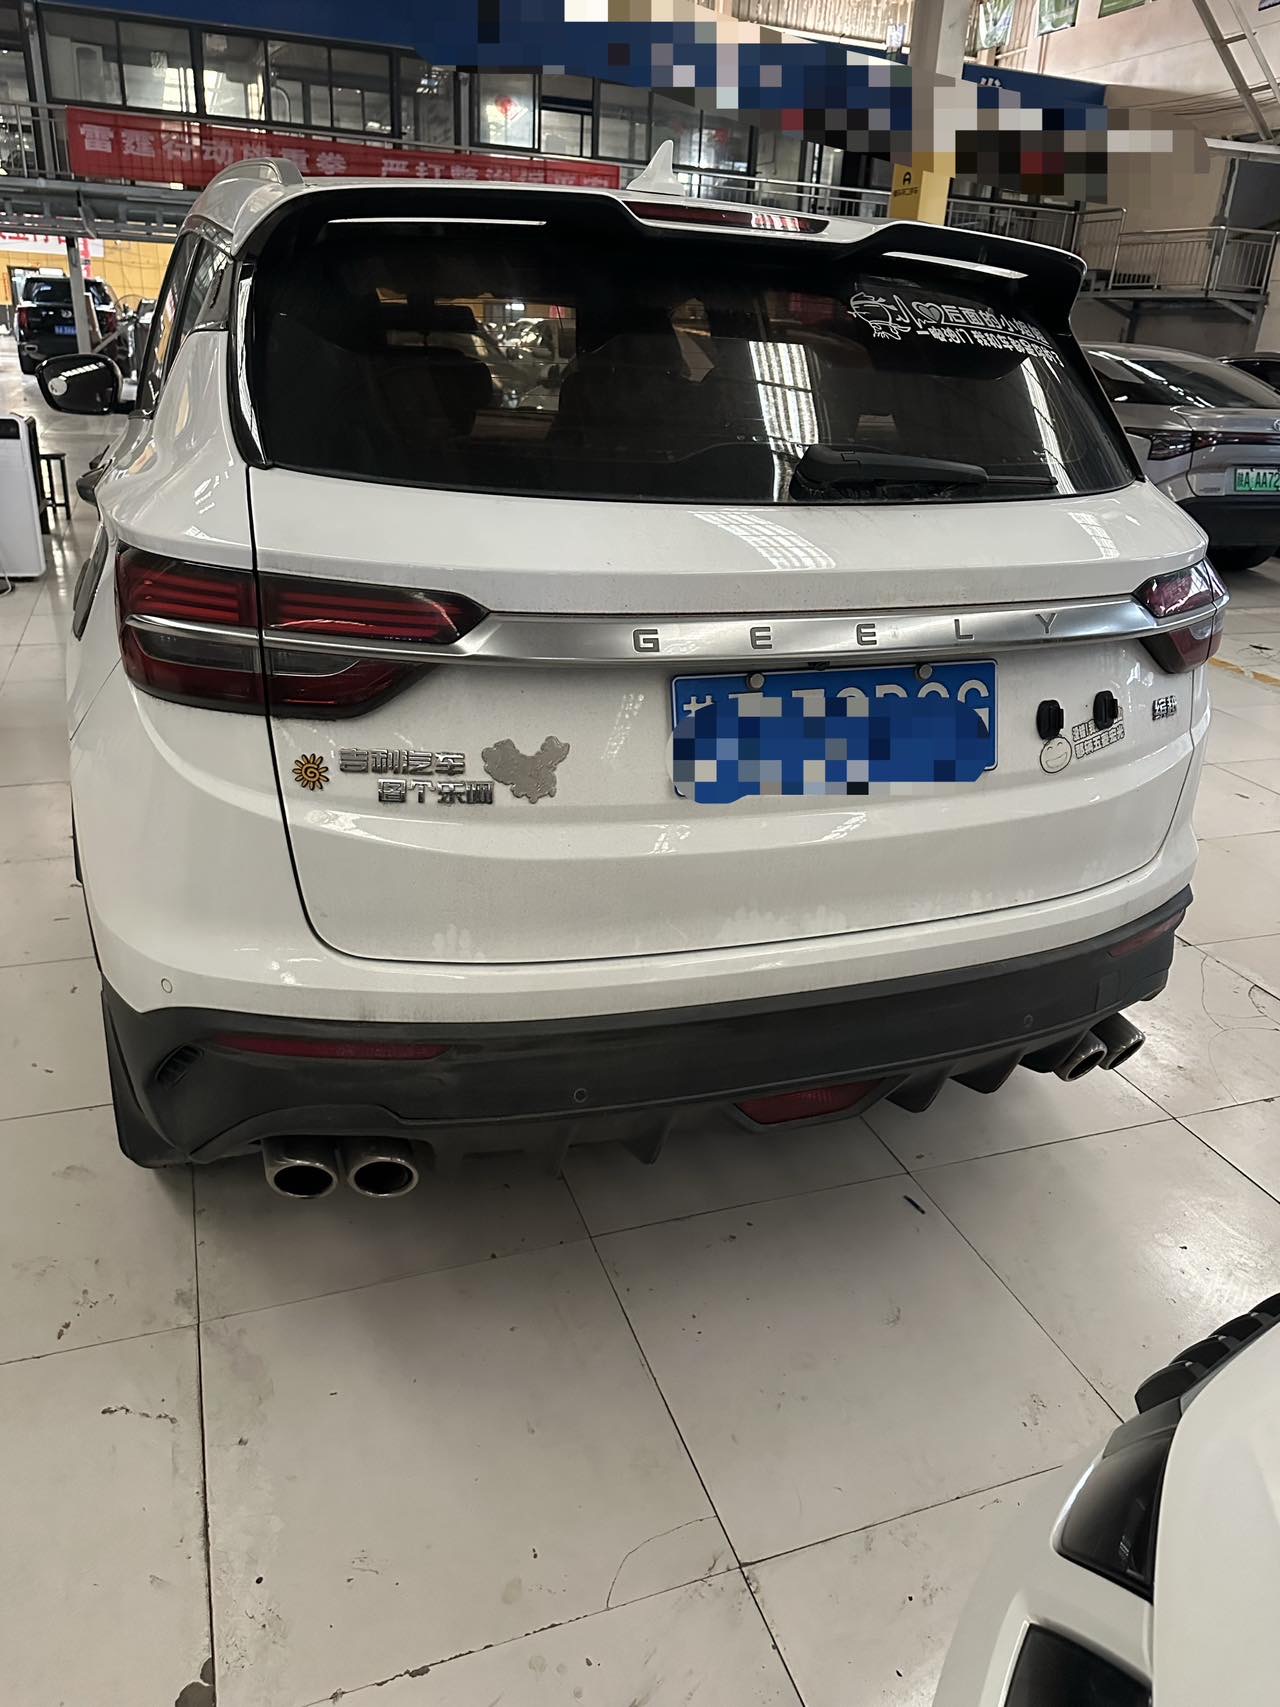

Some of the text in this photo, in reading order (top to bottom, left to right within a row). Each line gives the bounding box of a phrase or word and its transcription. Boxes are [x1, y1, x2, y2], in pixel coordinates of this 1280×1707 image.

[941, 304, 1050, 346] 后面的小姐姐
[632, 612, 1058, 653] GEELY
[339, 748, 467, 775] 吉利汽车
